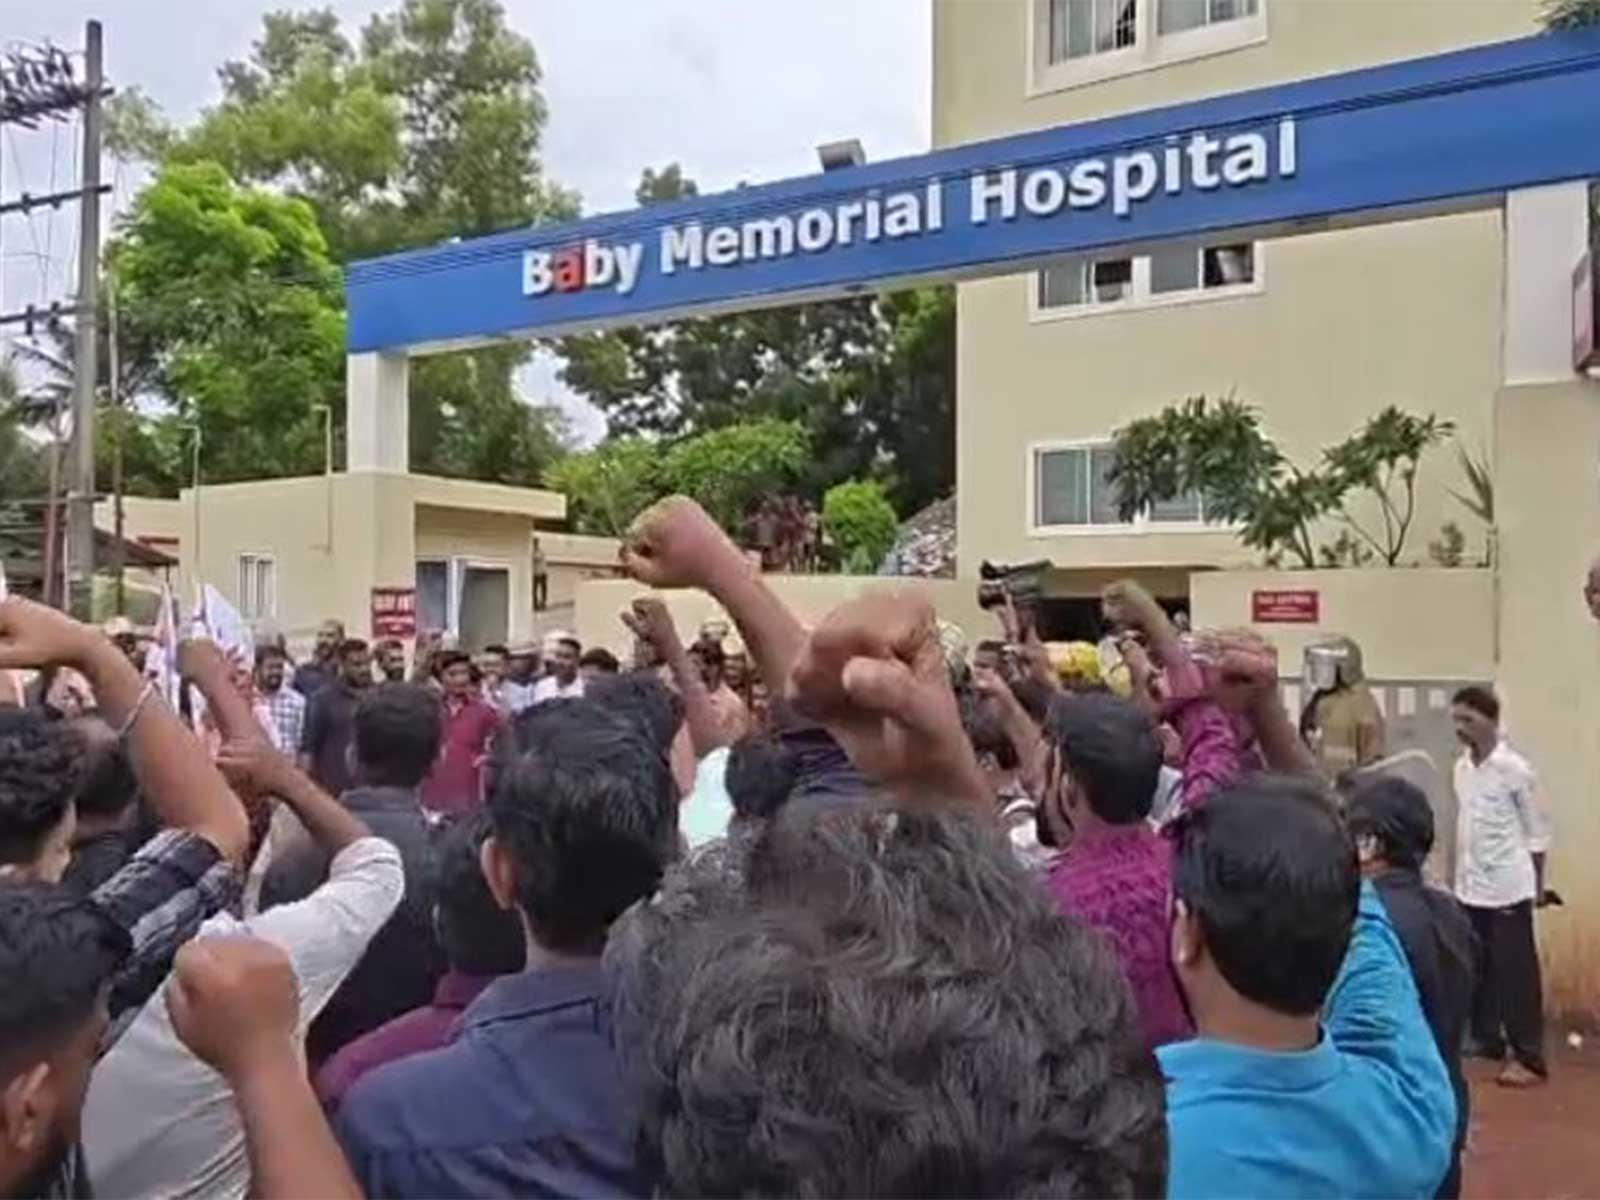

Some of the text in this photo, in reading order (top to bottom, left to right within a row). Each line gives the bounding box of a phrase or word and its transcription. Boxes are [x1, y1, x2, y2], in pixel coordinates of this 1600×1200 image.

[521, 115, 1297, 297] Baby Memorial Hospital
